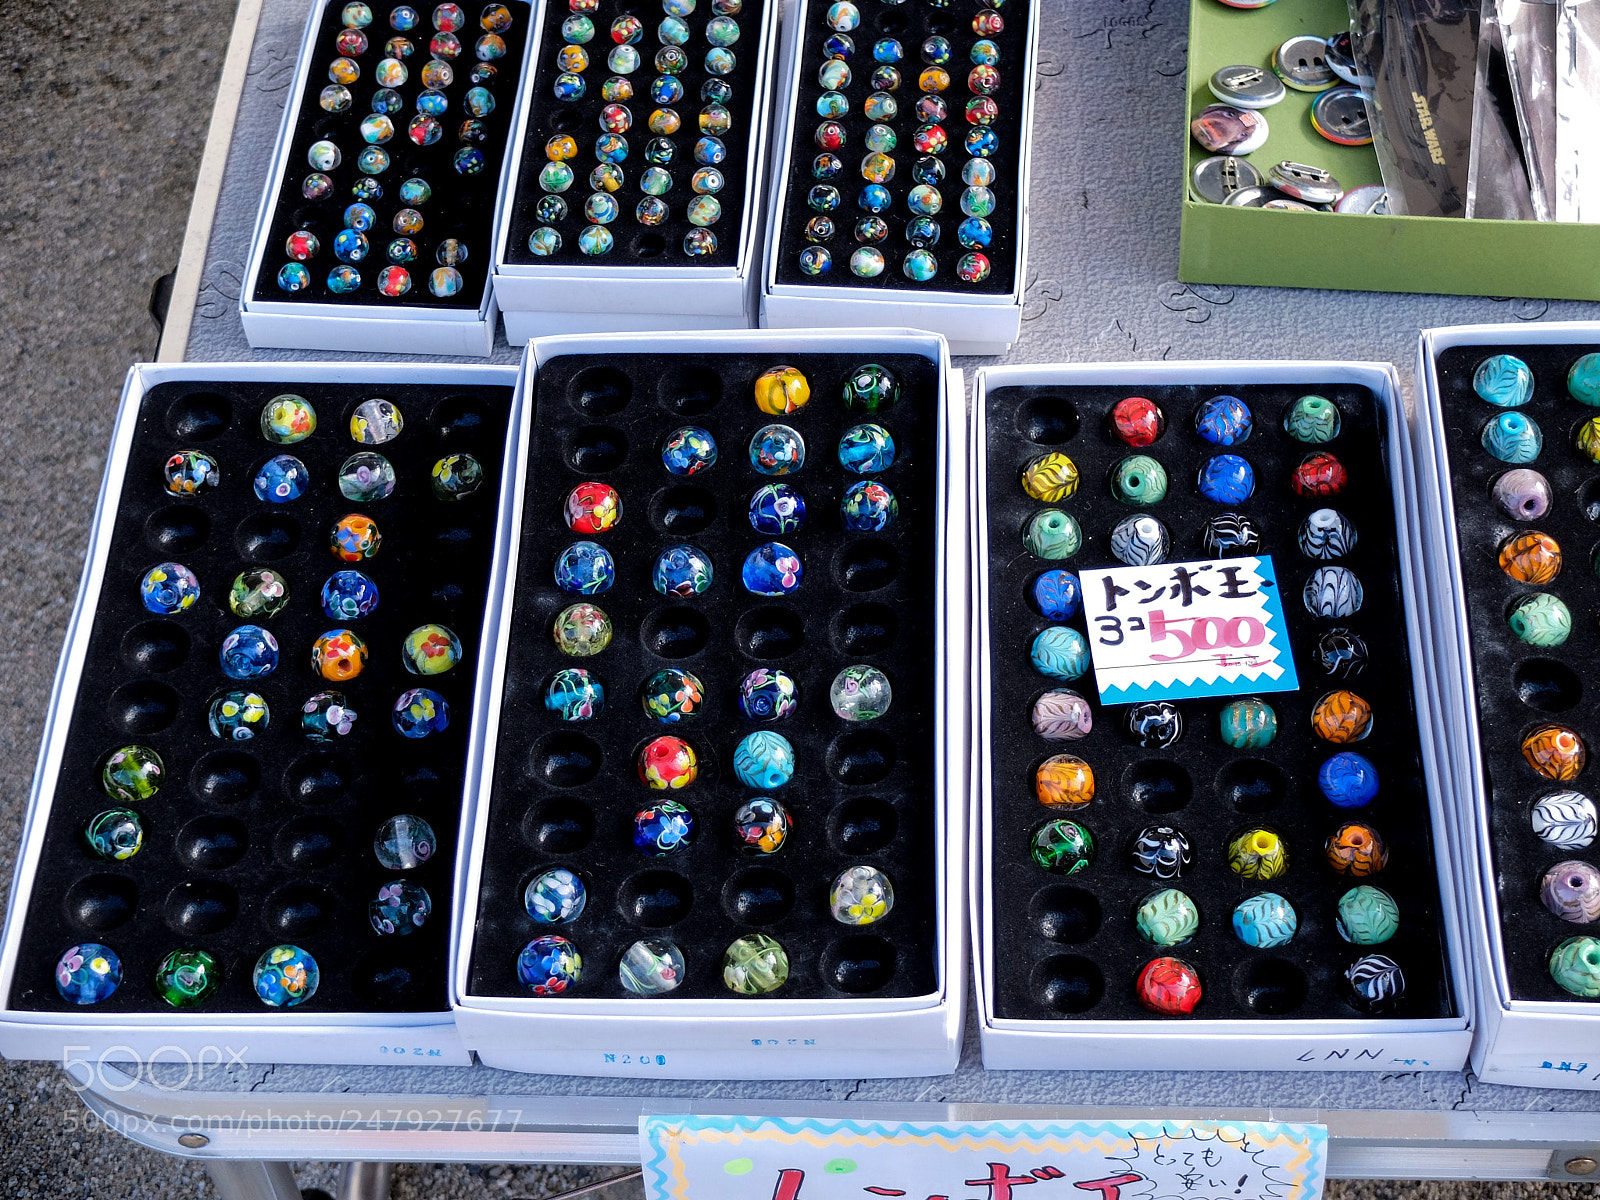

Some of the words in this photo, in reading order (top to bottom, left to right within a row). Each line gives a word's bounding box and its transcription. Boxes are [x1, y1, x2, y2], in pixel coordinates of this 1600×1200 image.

[1412, 92, 1433, 131] STAR
[1424, 128, 1446, 165] WARS
[1148, 609, 1266, 662] 500
[1153, 1143, 1222, 1168] とっても
